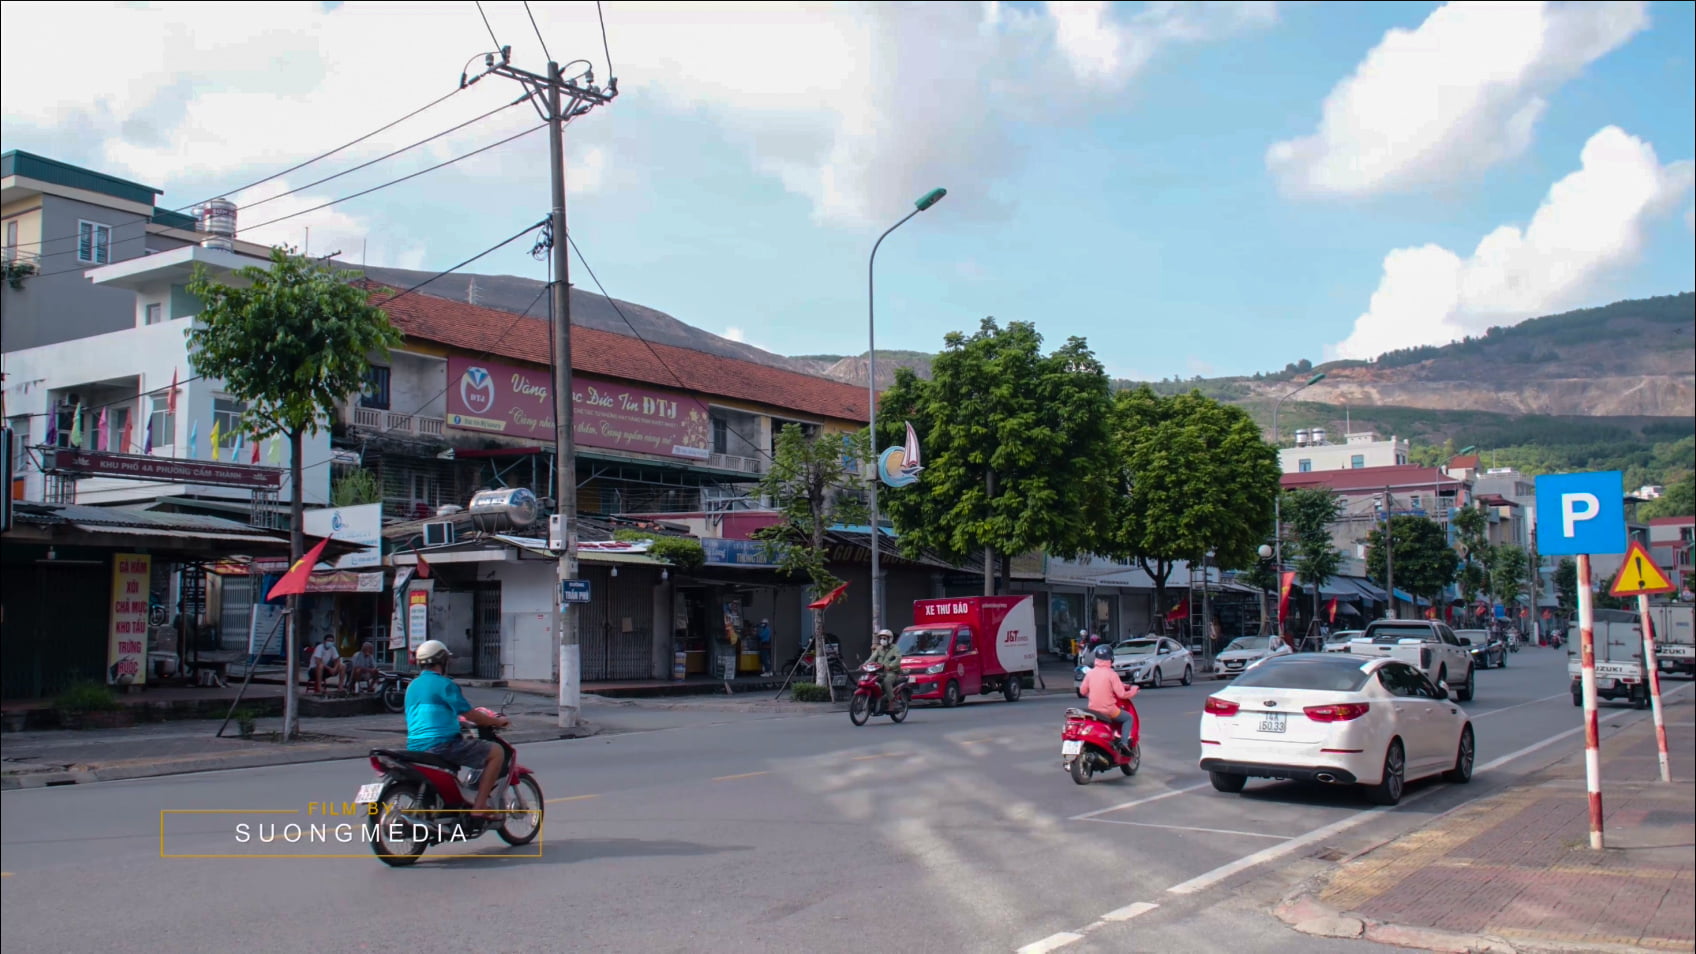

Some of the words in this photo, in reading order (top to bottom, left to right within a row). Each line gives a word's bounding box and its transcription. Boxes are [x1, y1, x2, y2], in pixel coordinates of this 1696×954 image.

[511, 373, 548, 404] Vàng
[100, 460, 119, 469] KHU
[142, 464, 153, 472] 4A
[1562, 492, 1600, 538] P
[926, 605, 935, 616] XE
[936, 603, 951, 614] THƯ
[953, 602, 968, 614] BÁO
[116, 621, 130, 633] KHO
